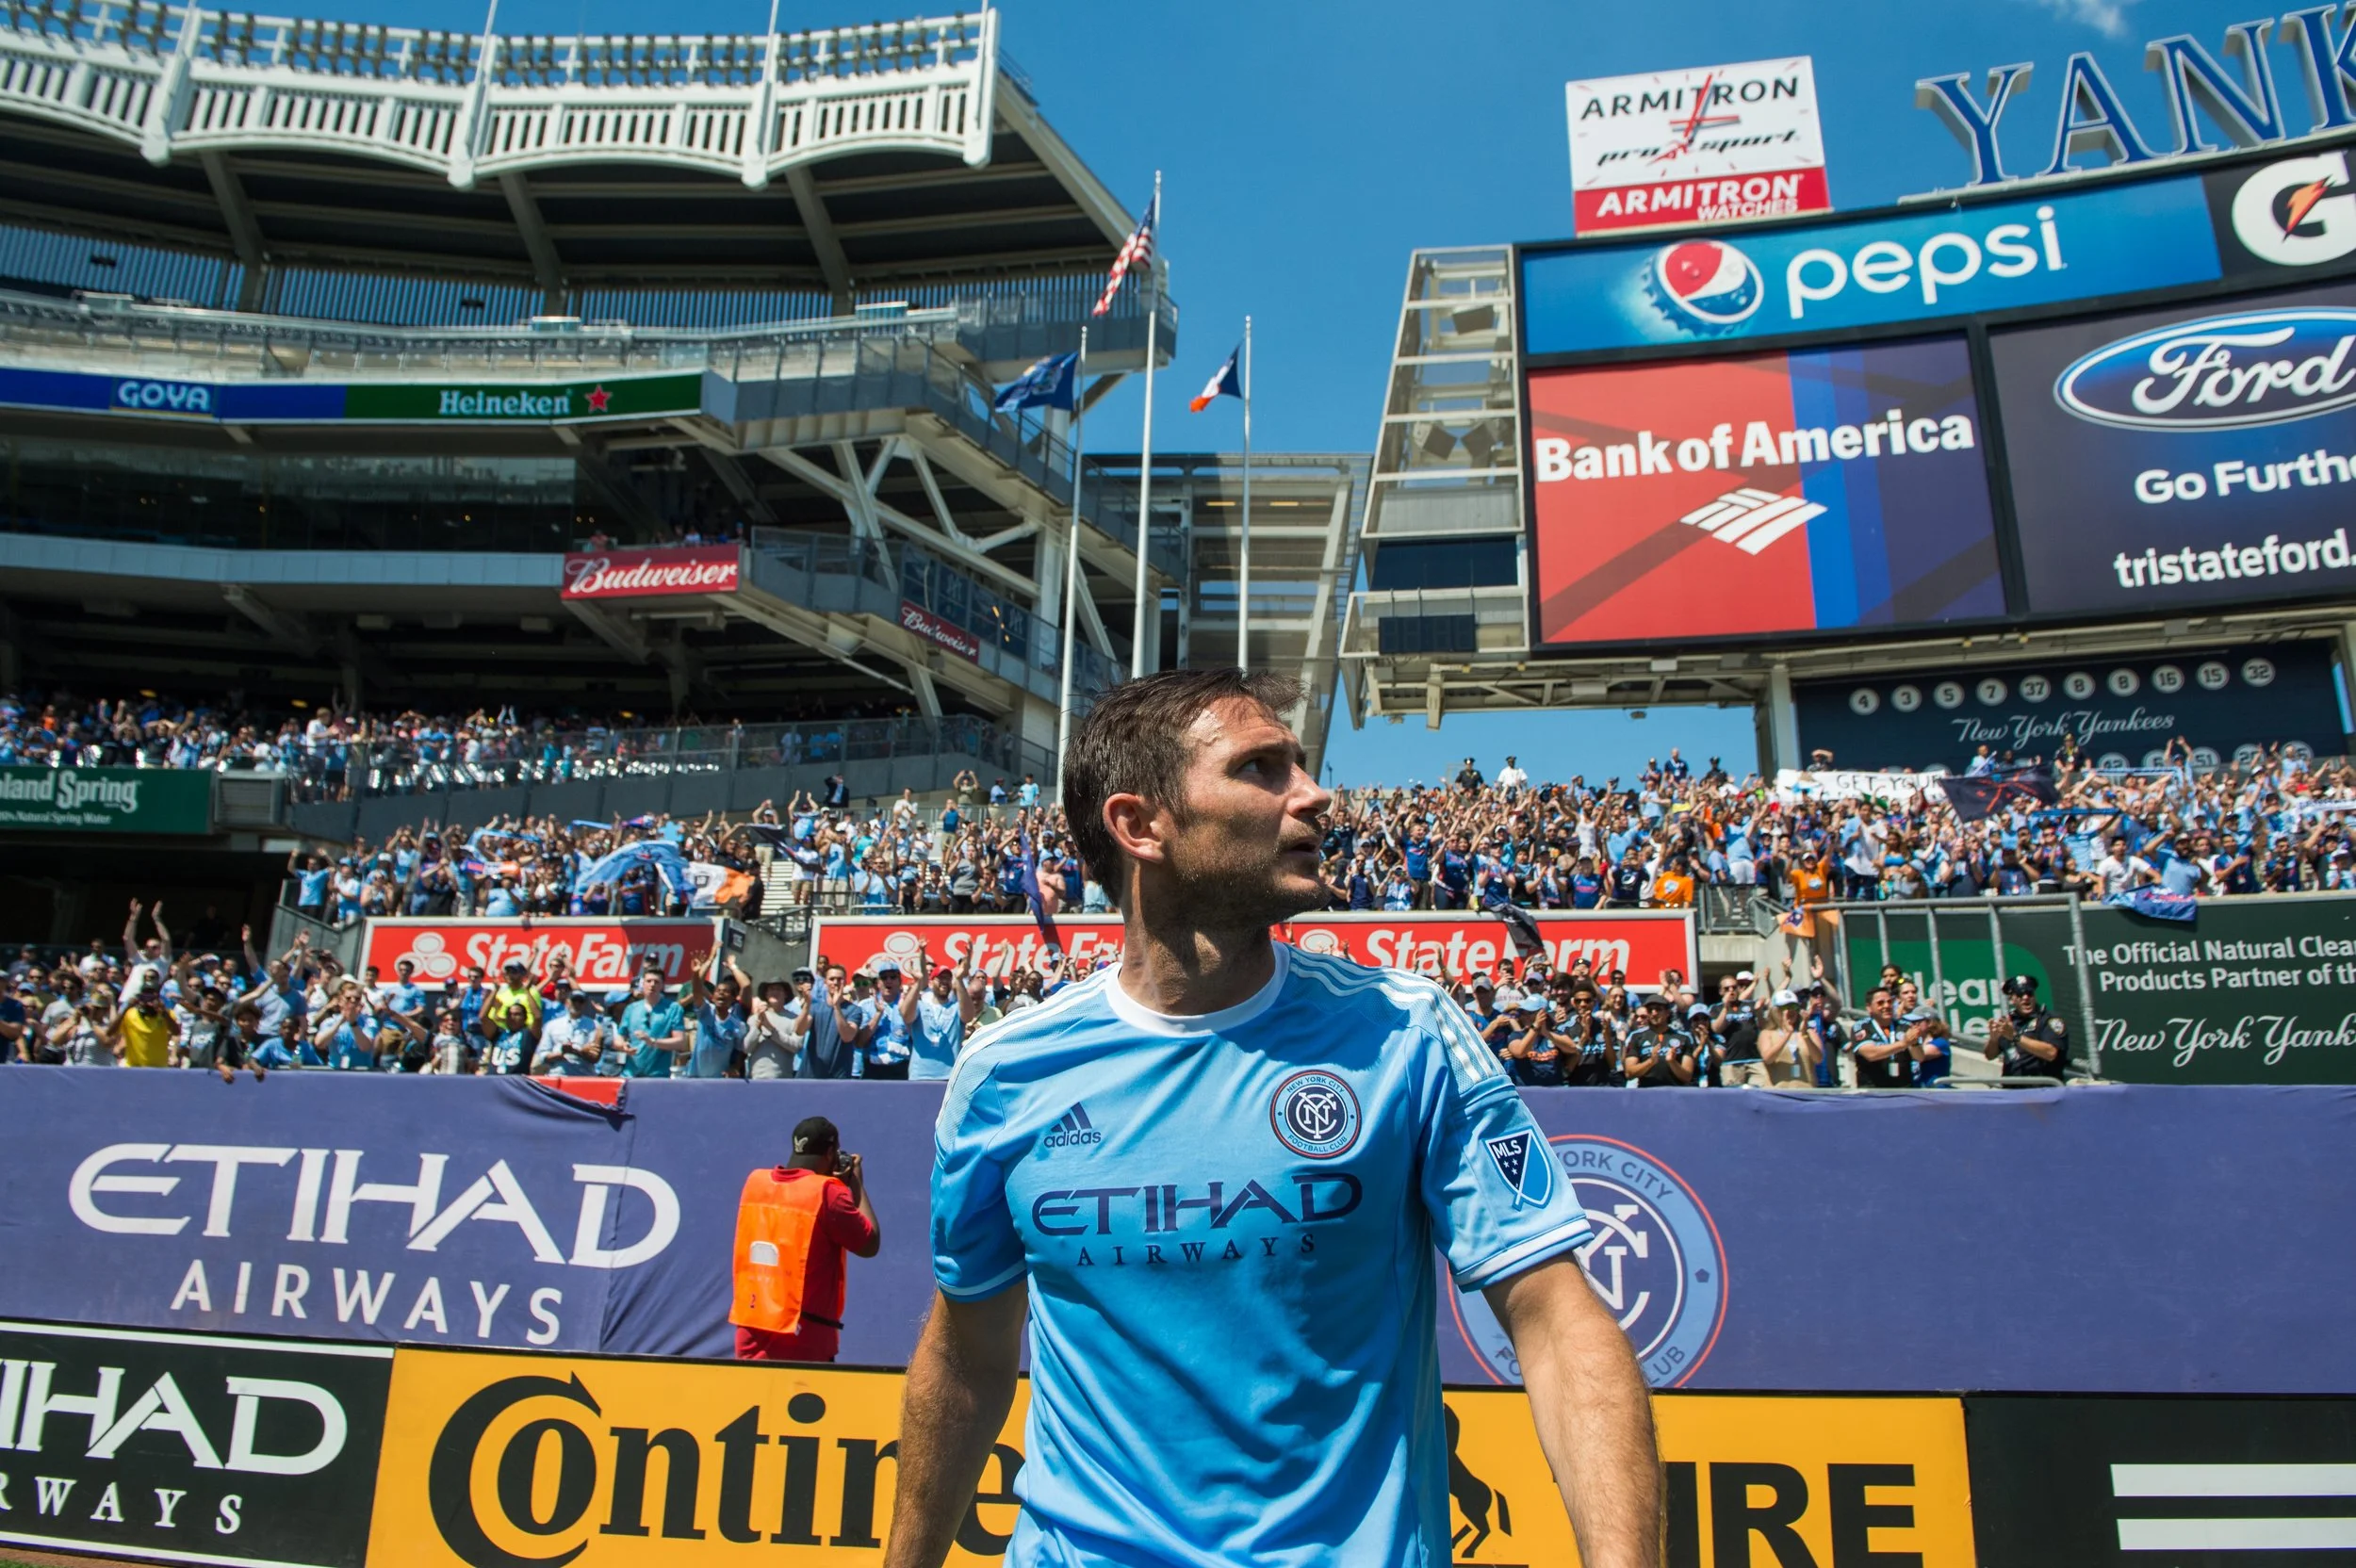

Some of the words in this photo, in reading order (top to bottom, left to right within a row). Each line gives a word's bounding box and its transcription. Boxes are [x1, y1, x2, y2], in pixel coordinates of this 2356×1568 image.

[1595, 173, 1800, 218] ARMITRON
[1696, 196, 1799, 221] WATCHES
[1787, 204, 2064, 319] pepsi
[2132, 326, 2356, 415] Ford
[118, 380, 211, 413] GOYA
[438, 388, 572, 416] Heineken
[1535, 430, 1674, 482] Bank
[1677, 423, 1733, 471] of
[1740, 407, 1975, 467] America
[2134, 469, 2207, 504] Go
[2214, 449, 2356, 497] Furth
[565, 556, 738, 595] Budweiser
[1858, 694, 1870, 709] 4
[1902, 691, 1913, 706] 3
[1943, 688, 1955, 702] 5
[1986, 684, 1997, 699] 7
[2025, 681, 2045, 697] 37
[2073, 678, 2086, 694] 8
[2117, 675, 2129, 690] 8
[2159, 672, 2178, 687] 16
[2203, 668, 2222, 683] 15
[2248, 664, 2270, 679] 32
[1951, 717, 2009, 743] New
[2009, 710, 2071, 751] York
[2073, 706, 2175, 746] Yankees
[57, 769, 139, 813] Spring
[1836, 774, 1878, 792] GET
[2112, 939, 2201, 965] Official
[2204, 937, 2296, 961] Natural
[2299, 935, 2356, 957] Clea
[2100, 969, 2206, 992] Products
[2211, 966, 2302, 988] Partner
[2307, 962, 2333, 986] of
[2094, 1018, 2166, 1053] New
[2167, 1015, 2255, 1068] York
[1286, 1079, 1304, 1093] NEW
[1328, 1080, 1346, 1094] CITY
[1043, 1129, 1102, 1149] adidas
[1287, 1134, 1329, 1152] FOOTBALL
[1329, 1135, 1348, 1151] CLUB
[1491, 1139, 1523, 1160] MLS
[1620, 1160, 1674, 1201] CITY
[68, 1142, 681, 1268] ETIHAD
[1031, 1171, 1364, 1236] ETIHAD
[1076, 1233, 1315, 1266] AIRWAYS
[170, 1258, 564, 1346] AIRWAYS
[1648, 1345, 1686, 1385] LUB
[0, 1358, 348, 1476] IHAD
[1663, 1461, 1924, 1568] IRE
